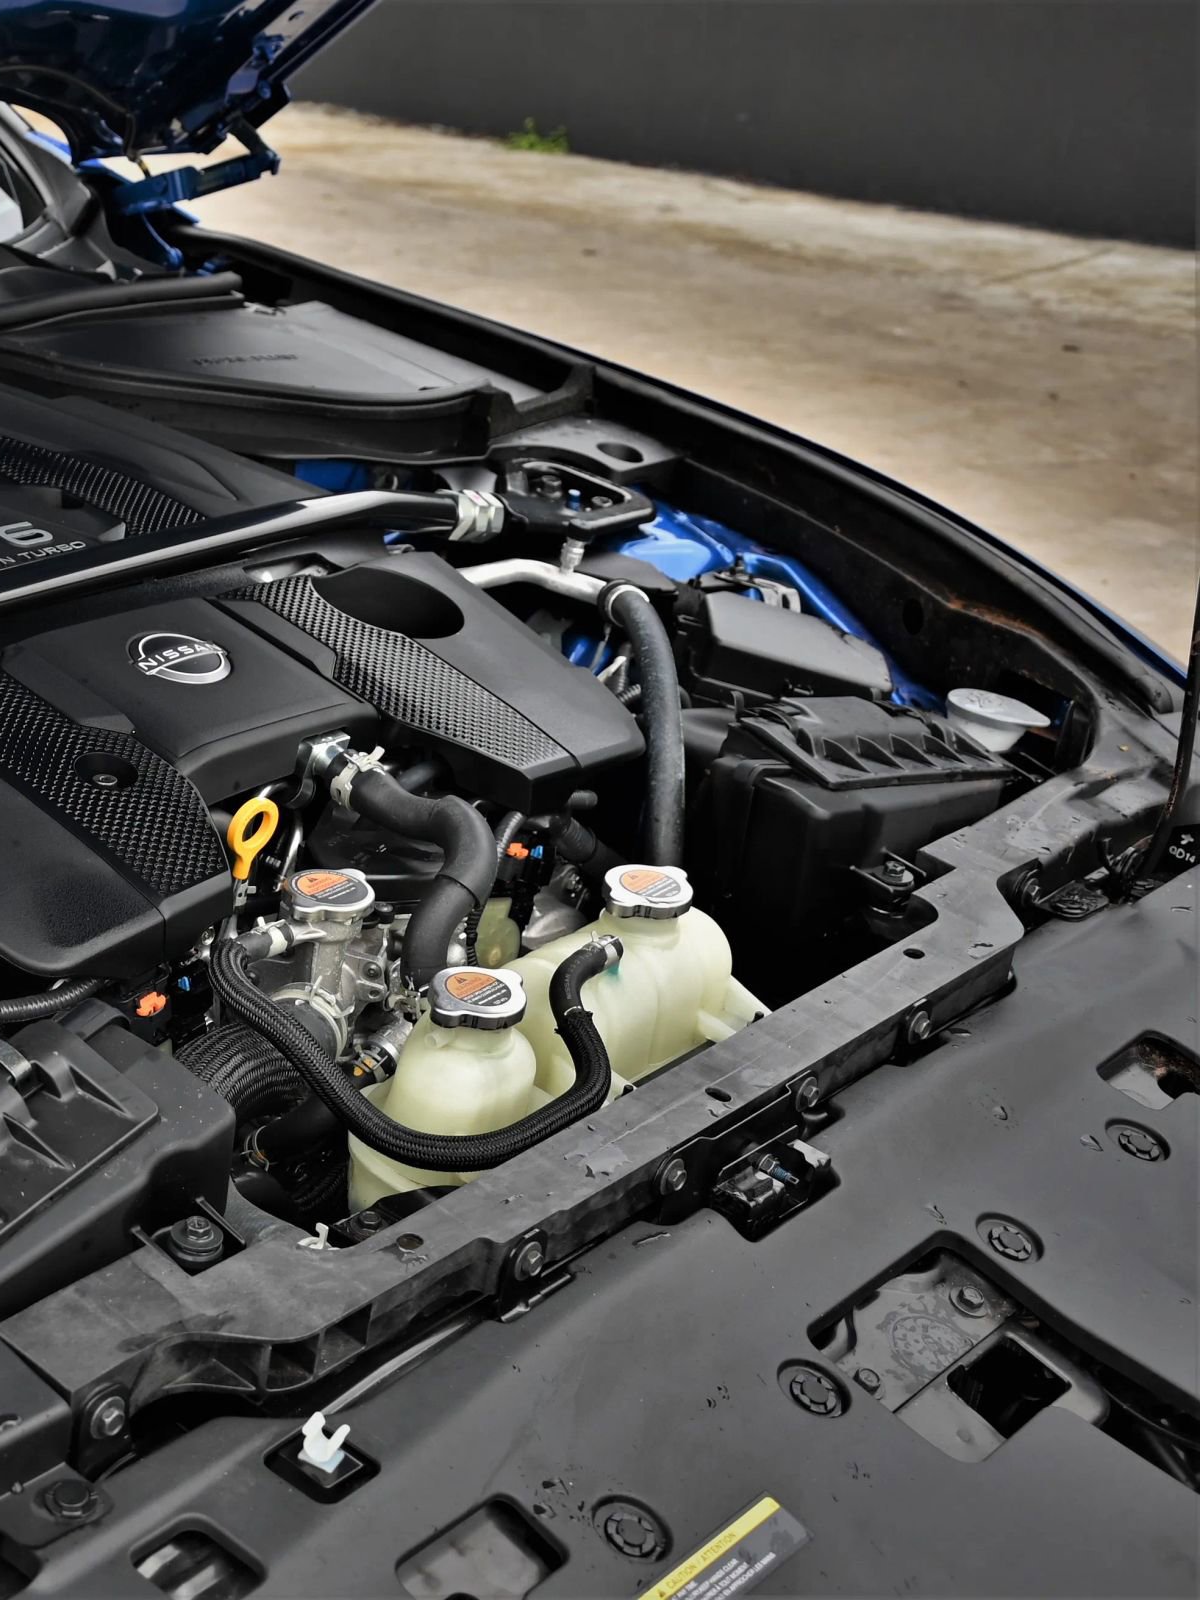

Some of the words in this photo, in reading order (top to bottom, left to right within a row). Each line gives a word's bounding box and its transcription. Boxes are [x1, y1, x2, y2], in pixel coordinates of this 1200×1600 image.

[17, 541, 87, 560] TURBO
[138, 643, 222, 671] NISSAN
[666, 1563, 698, 1588] CAUTION
[701, 1532, 737, 1561] ATTENTION
